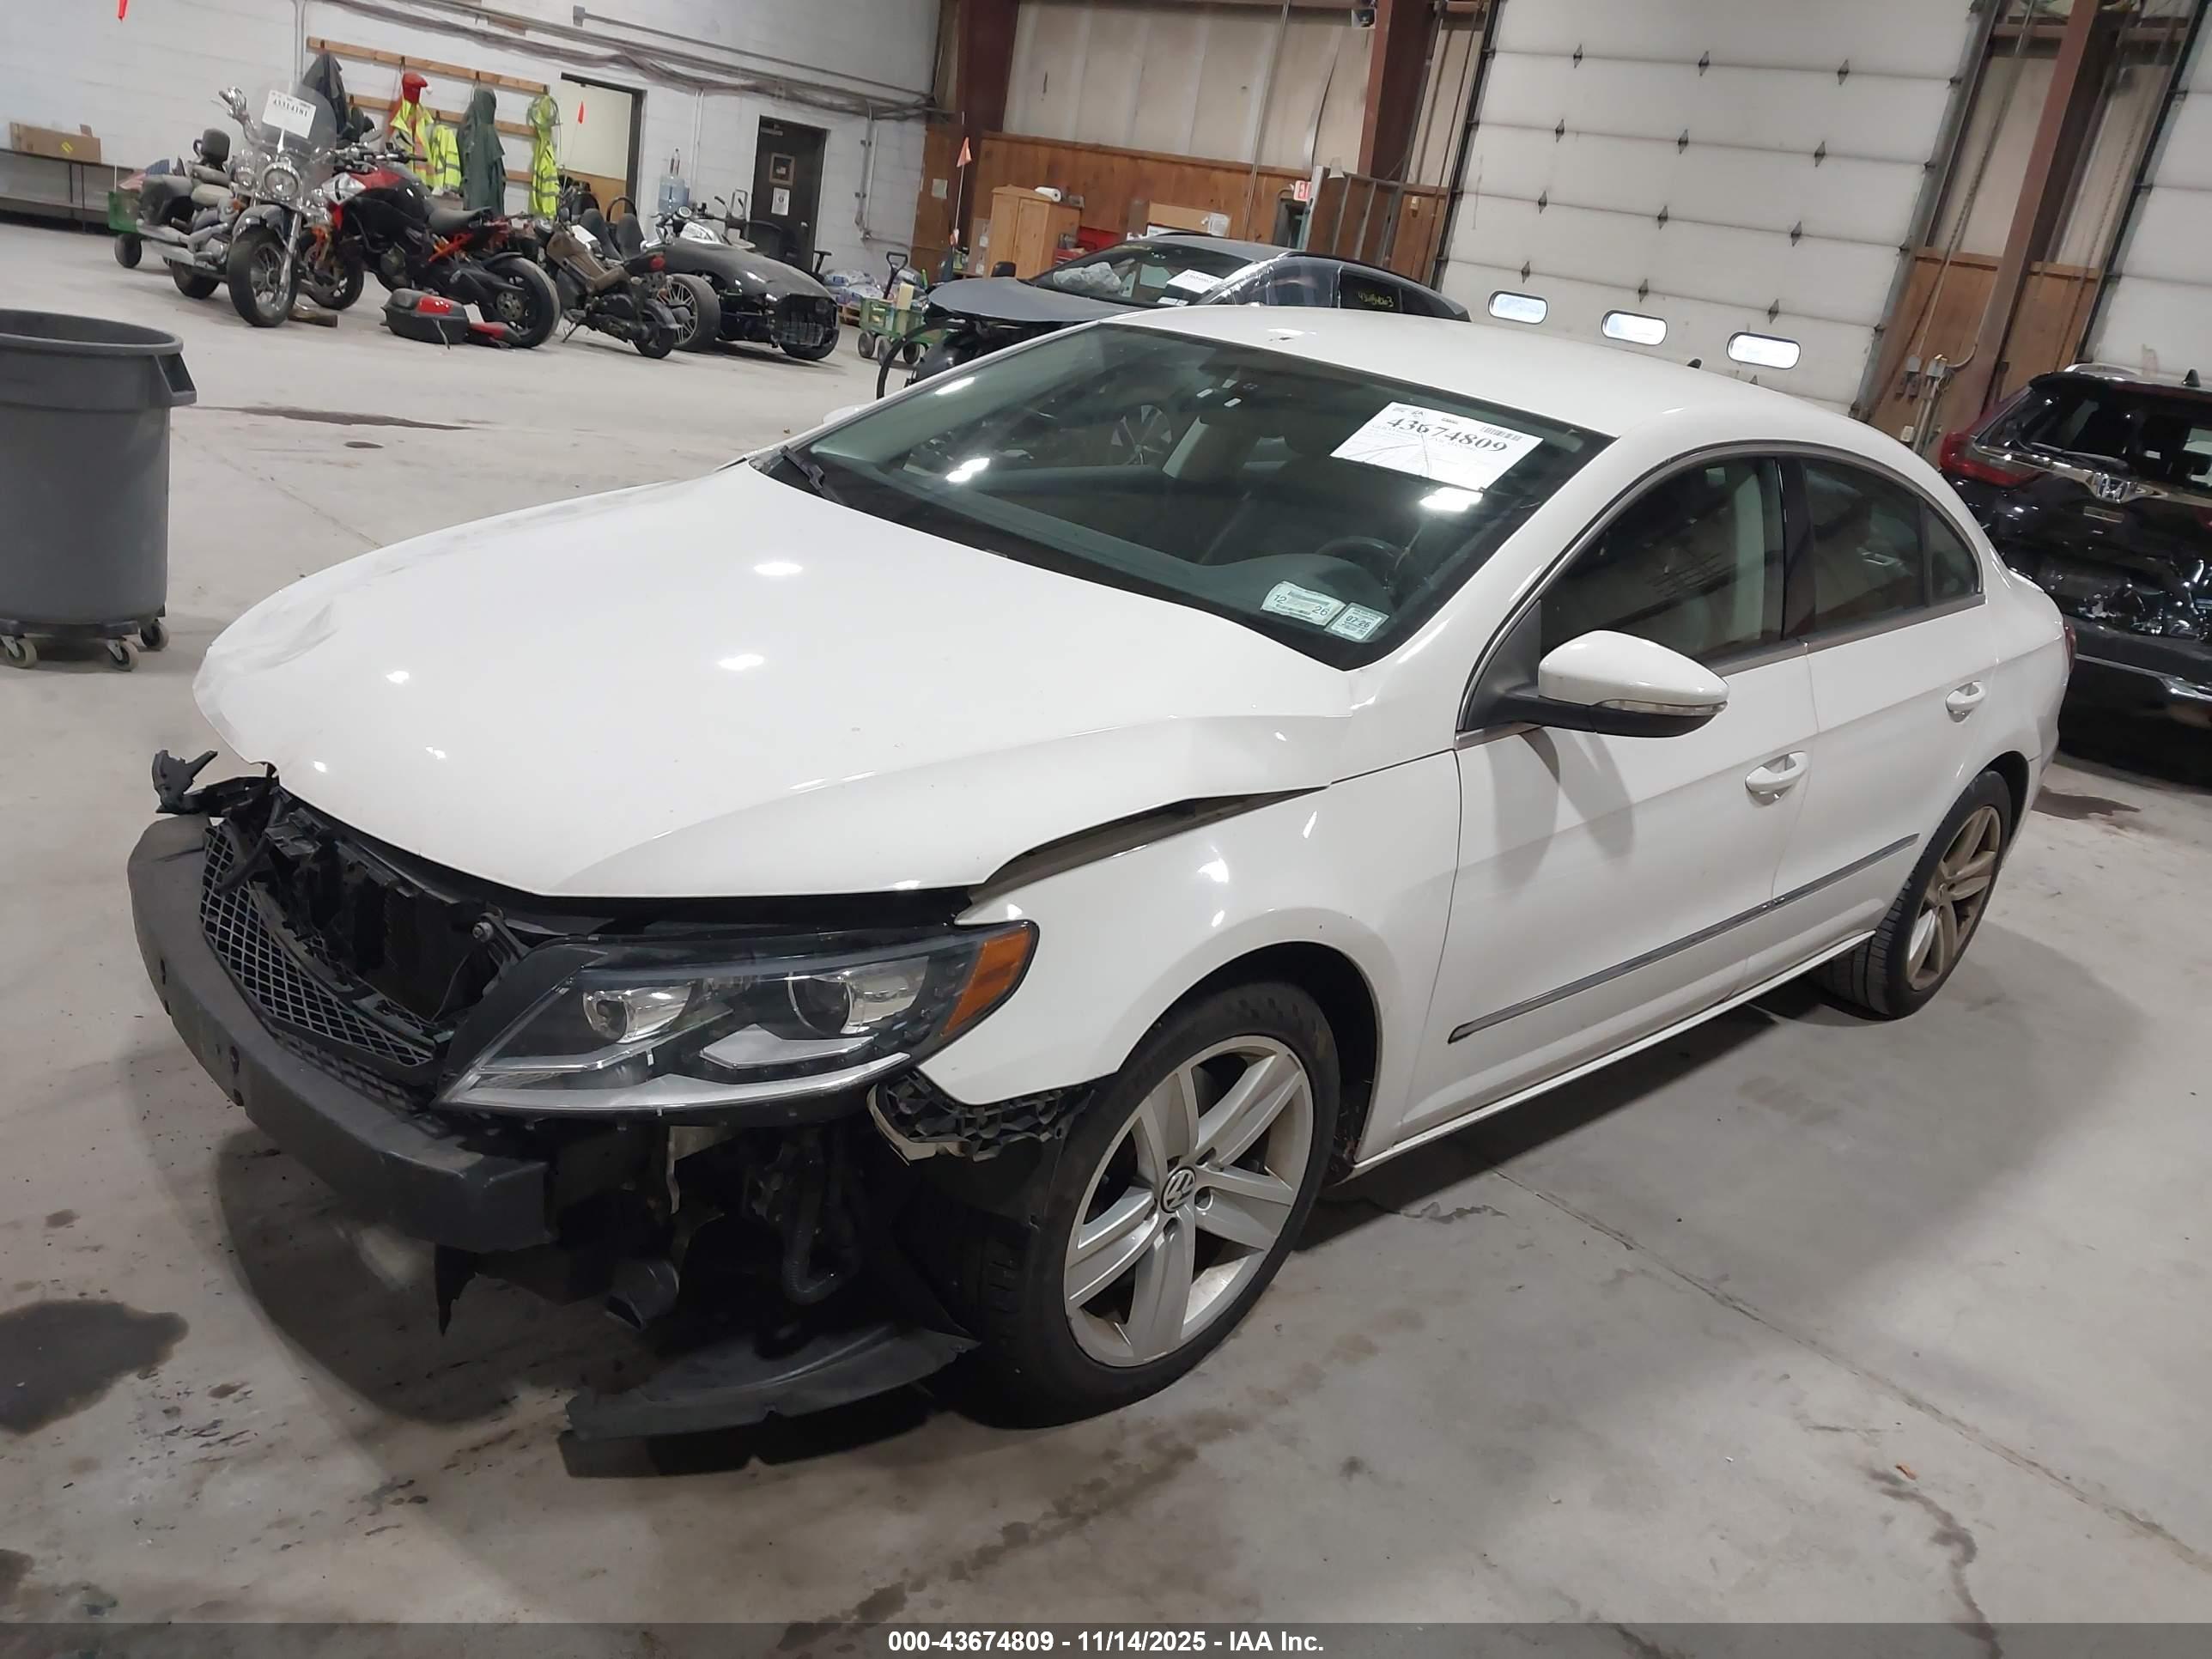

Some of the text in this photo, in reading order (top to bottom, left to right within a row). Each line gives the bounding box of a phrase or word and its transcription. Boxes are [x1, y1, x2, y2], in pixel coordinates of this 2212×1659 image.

[1386, 417, 1509, 453] 43674809
[1273, 593, 1288, 605] 12
[1311, 605, 1330, 617] 26
